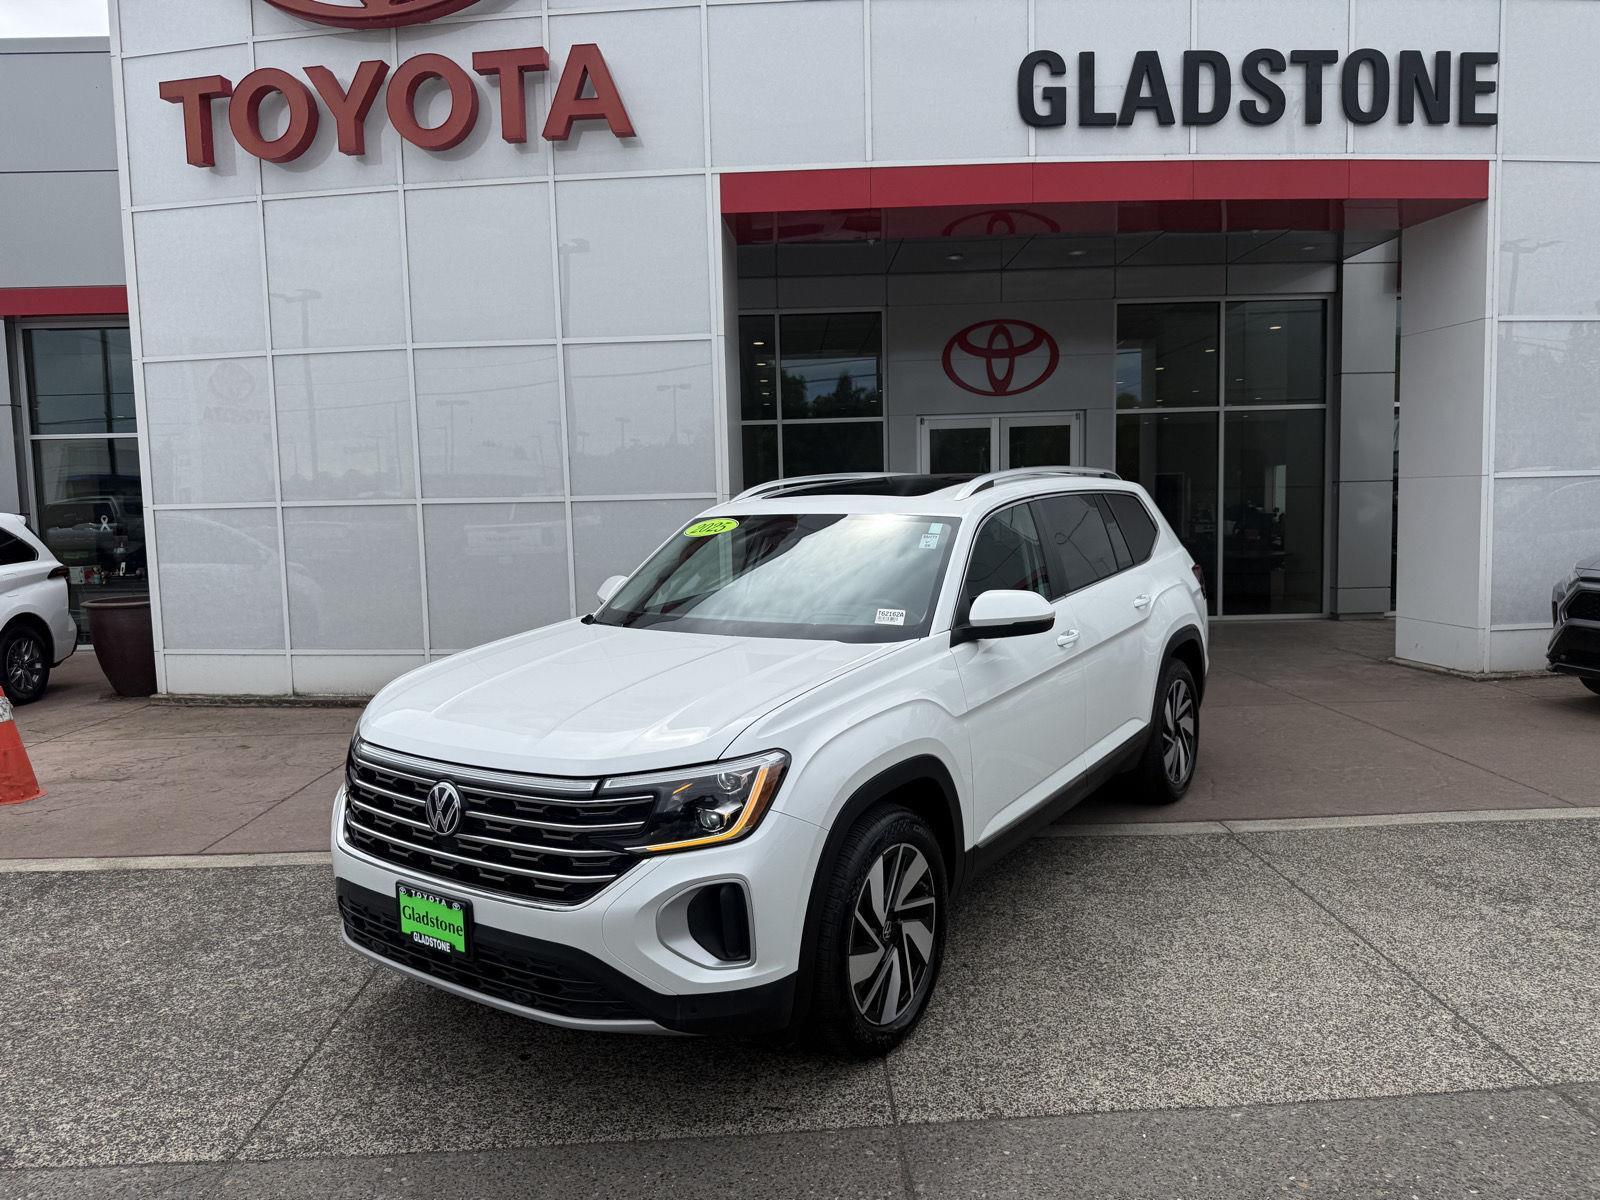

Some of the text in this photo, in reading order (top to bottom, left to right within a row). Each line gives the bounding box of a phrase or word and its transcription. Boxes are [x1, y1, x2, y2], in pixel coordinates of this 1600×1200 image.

[1018, 48, 1498, 127] GLADSTONE
[159, 43, 636, 167] TOYOTA
[690, 521, 732, 534] 2025
[411, 889, 446, 906] TOYOTA
[402, 905, 463, 936] Gladstone
[413, 931, 451, 953] GLADSTONE
